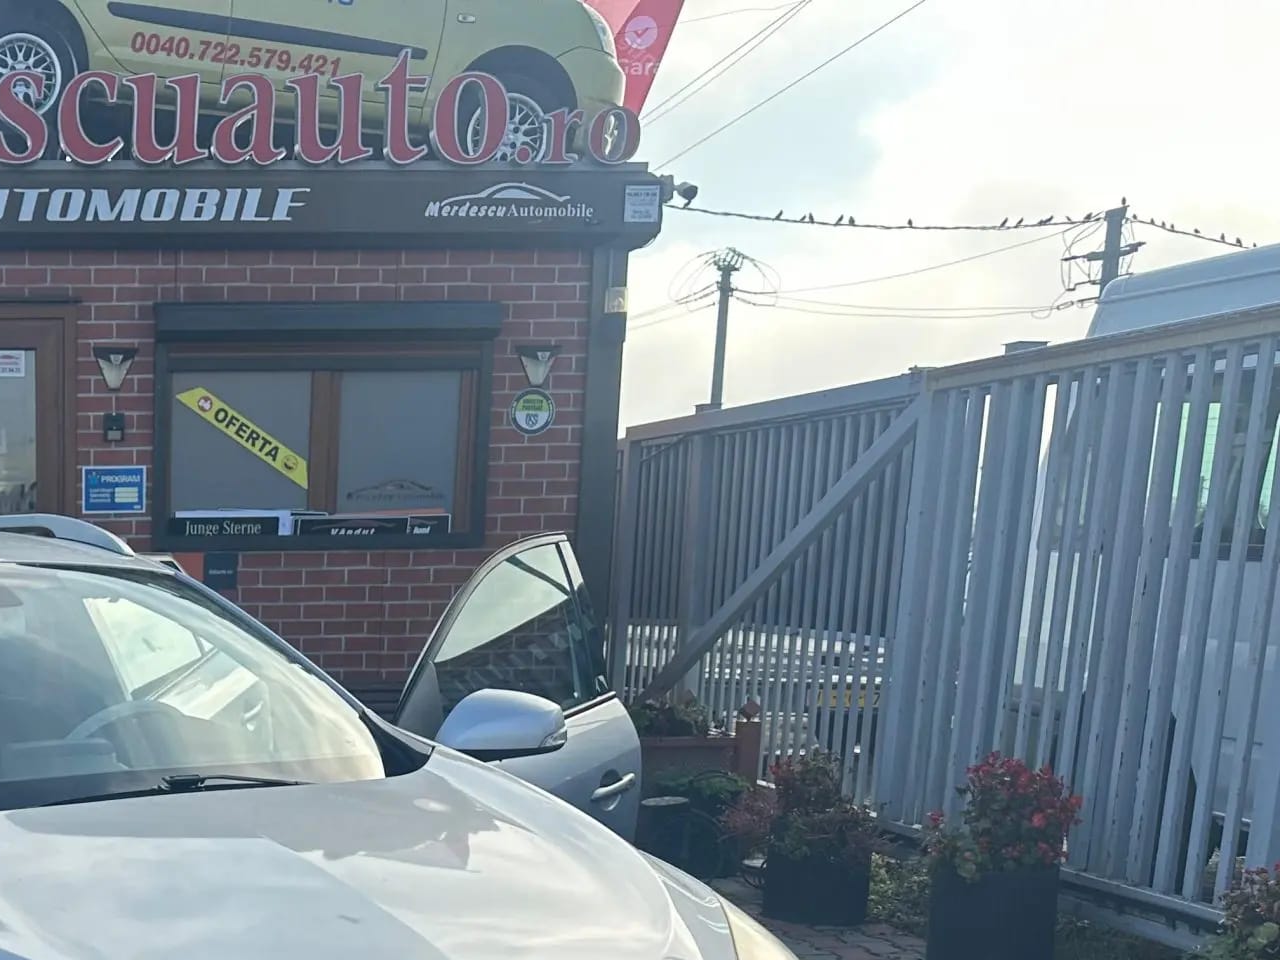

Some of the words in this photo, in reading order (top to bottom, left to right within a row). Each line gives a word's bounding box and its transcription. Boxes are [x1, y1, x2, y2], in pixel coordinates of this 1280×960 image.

[130, 31, 342, 77] 0040.722.579.421
[214, 407, 280, 462] OFERTA
[101, 475, 140, 483] PROGRAM
[185, 521, 220, 536] Junge
[222, 520, 262, 535] Sterne
